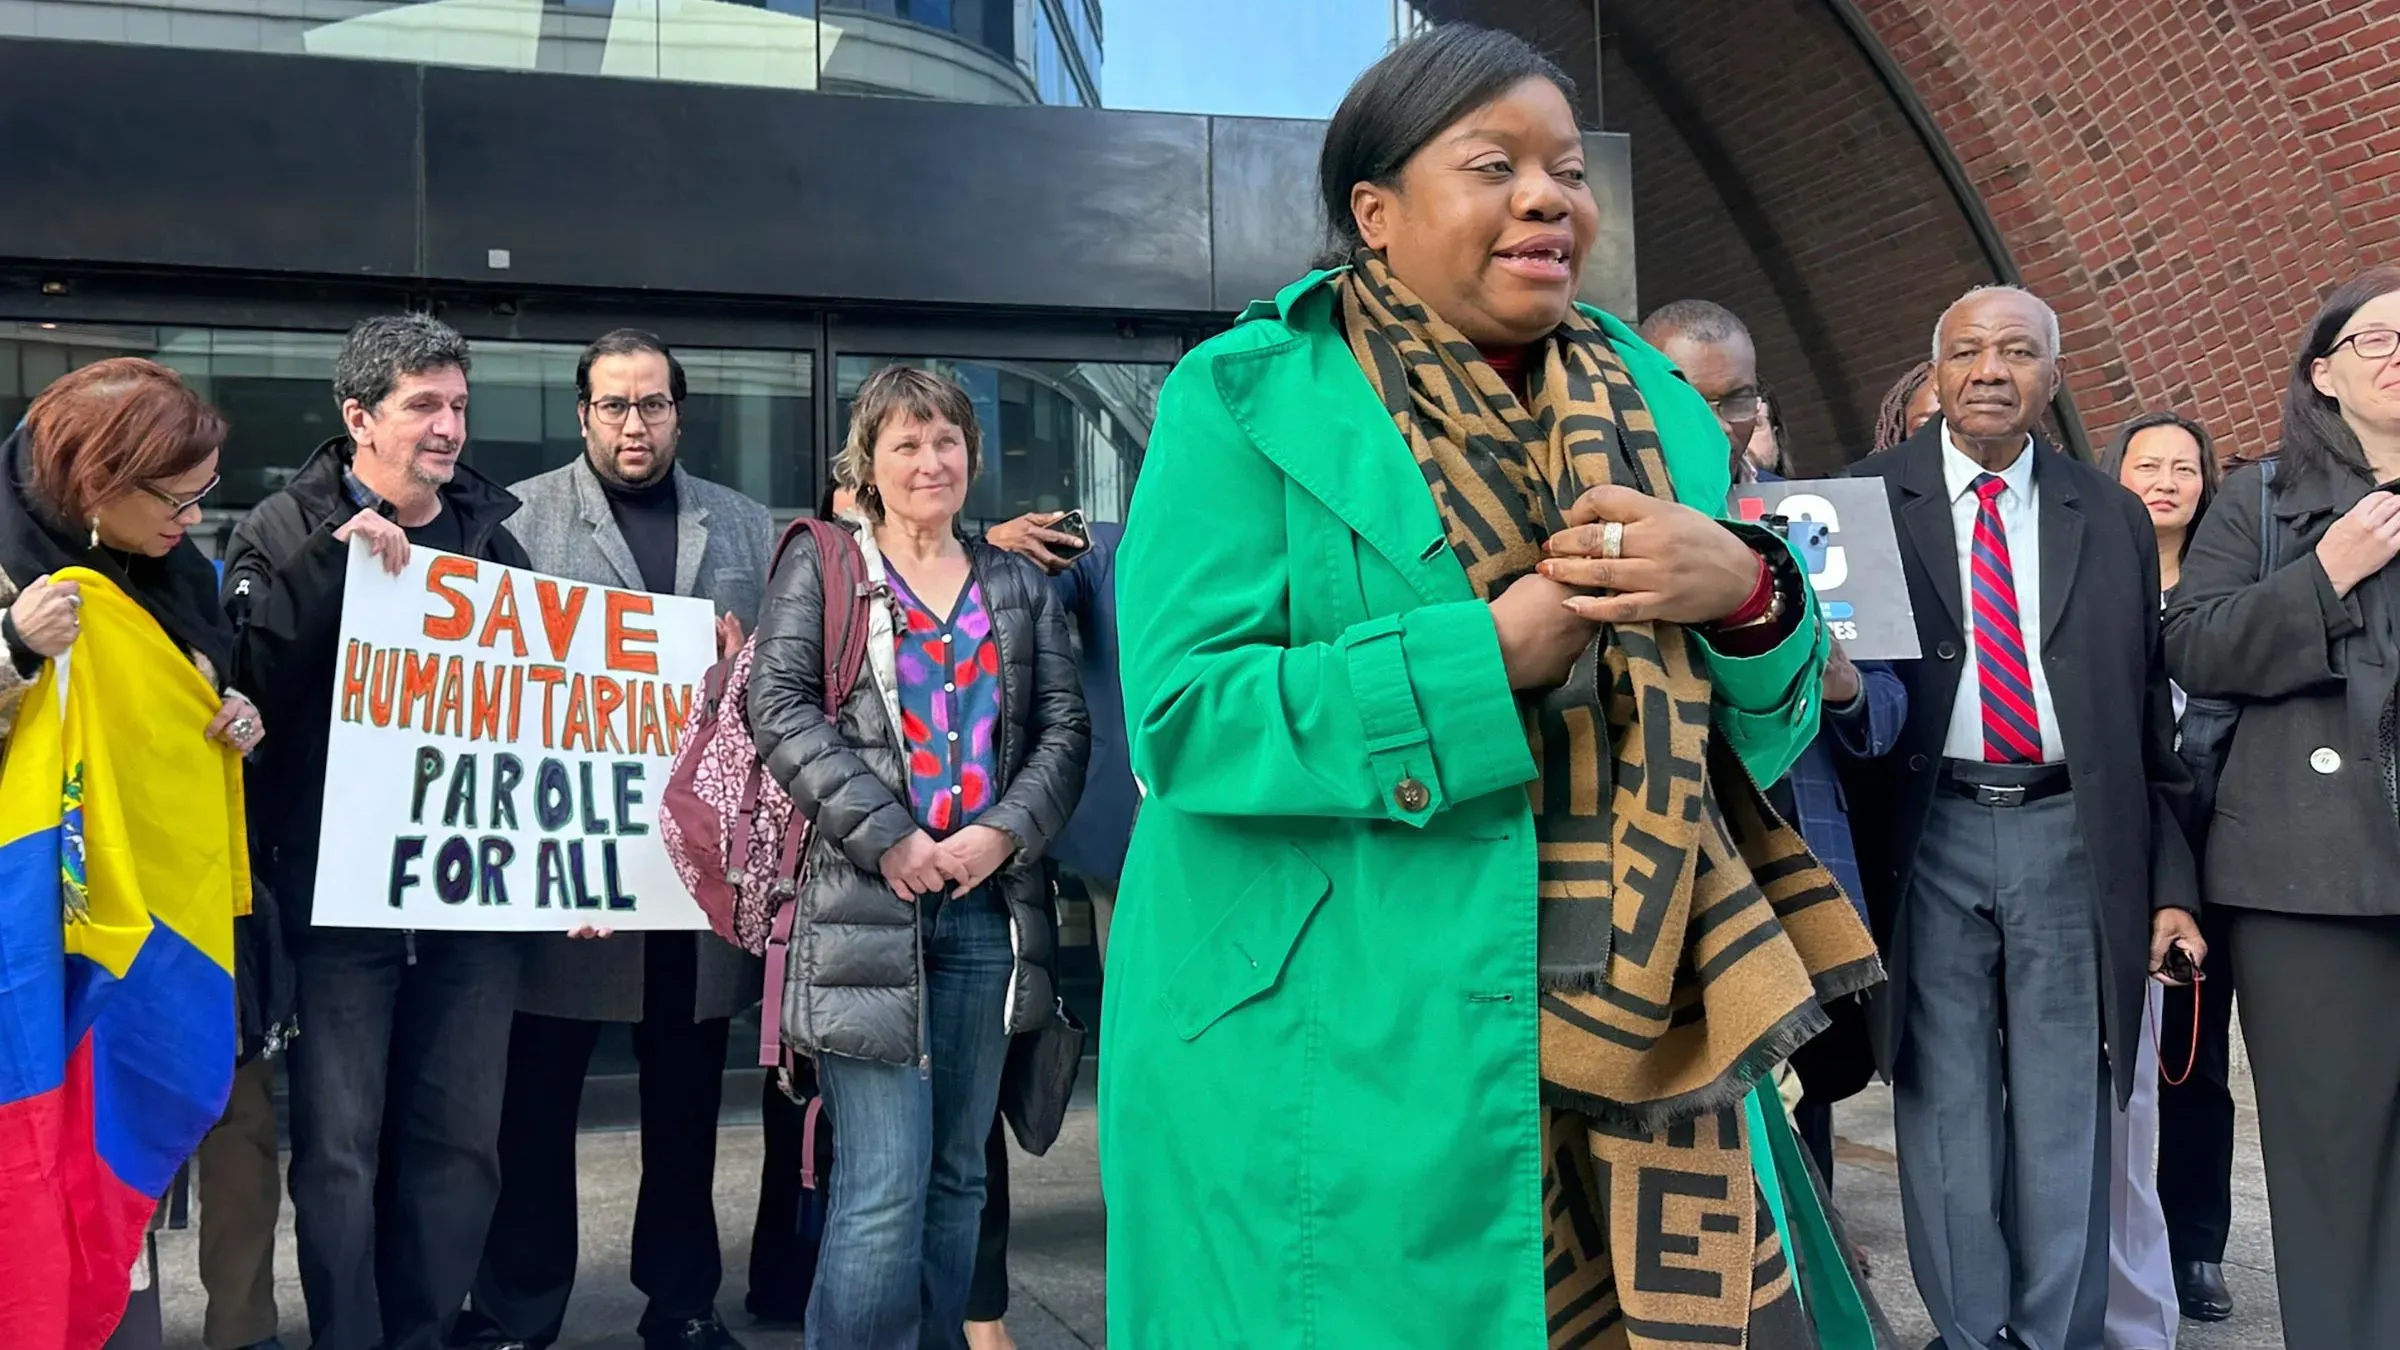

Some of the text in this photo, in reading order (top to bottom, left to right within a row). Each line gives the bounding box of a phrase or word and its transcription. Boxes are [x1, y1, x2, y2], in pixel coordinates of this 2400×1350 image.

[423, 556, 659, 675] SAVE
[341, 638, 693, 756] HUMANITARIAN
[411, 745, 649, 836] PAROLE
[388, 834, 637, 911] FOR ALL
